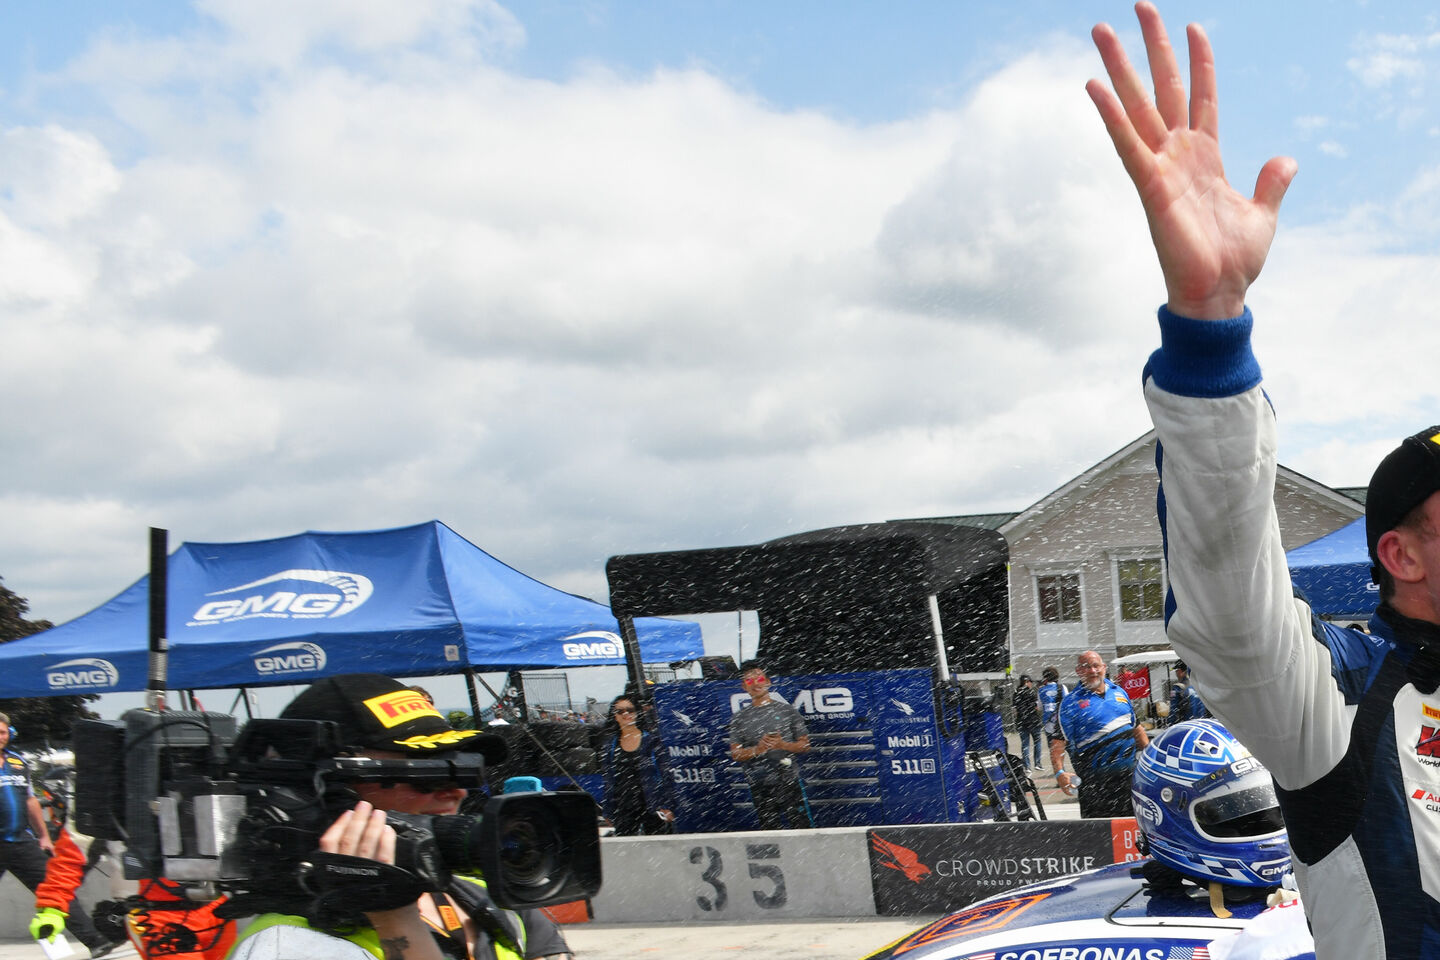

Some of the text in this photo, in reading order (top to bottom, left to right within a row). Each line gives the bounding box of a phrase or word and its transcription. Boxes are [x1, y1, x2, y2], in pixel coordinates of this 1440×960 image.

[193, 592, 343, 620] GMG
[563, 642, 618, 657] GMG
[254, 654, 317, 672] GMG
[47, 671, 106, 686] GMG
[888, 736, 920, 747] Mobil
[891, 760, 921, 774] 5.11
[1418, 758, 1440, 768] World
[326, 864, 378, 876] FUJINON
[936, 856, 1095, 877] CROWDSTRIKE
[689, 843, 787, 912] 35
